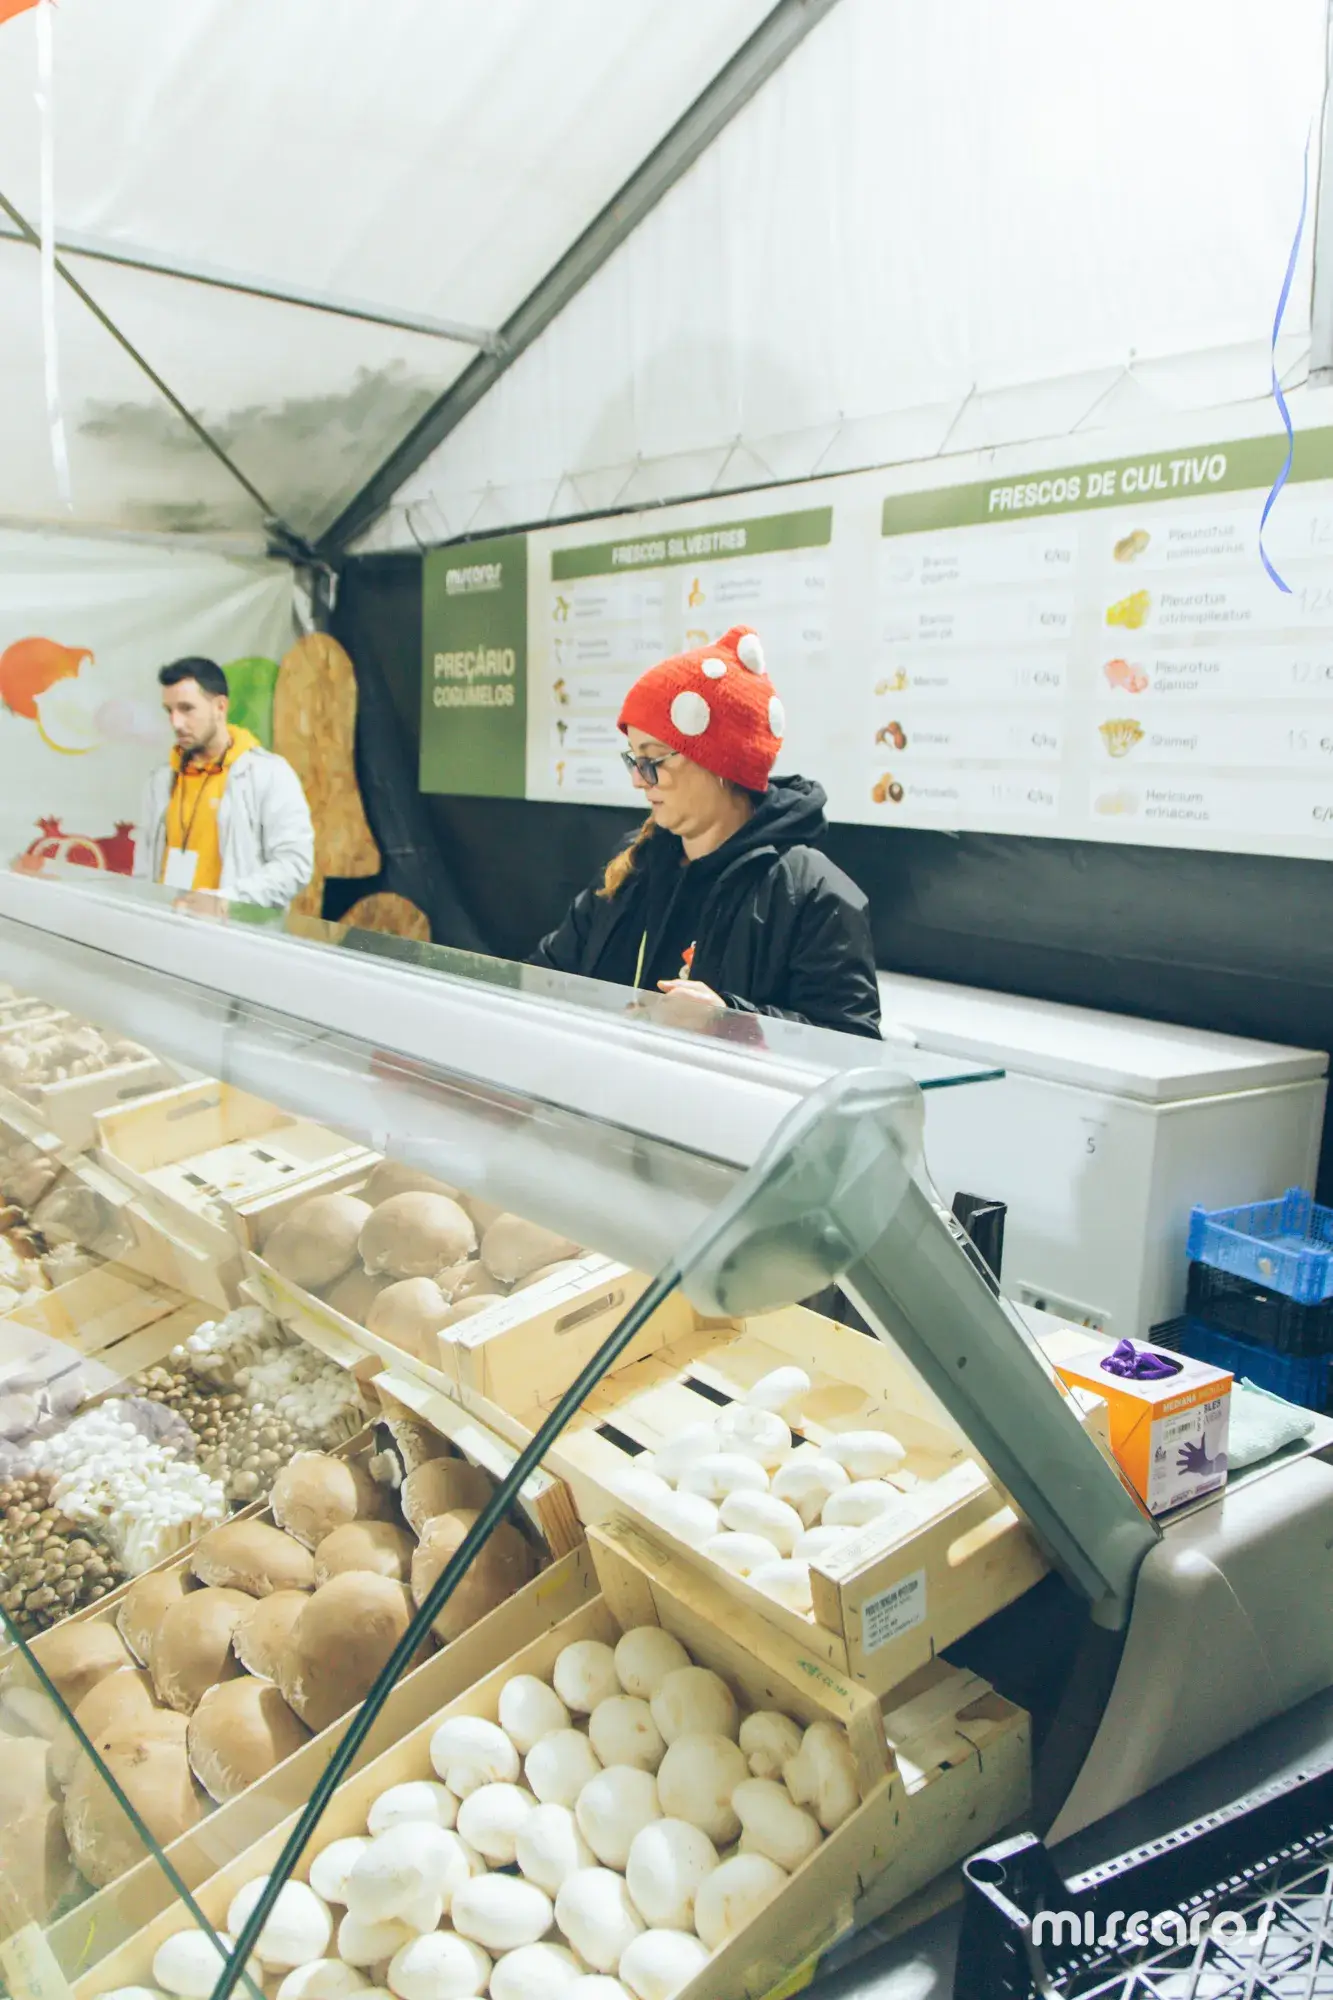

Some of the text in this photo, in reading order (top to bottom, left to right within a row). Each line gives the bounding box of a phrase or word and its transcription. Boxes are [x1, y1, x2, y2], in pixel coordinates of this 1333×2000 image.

[988, 453, 1227, 513] FRESCOS DE CULTIVO
[611, 527, 747, 565] FRESCOS SILVESTRES
[1160, 591, 1227, 609] Pleurotus
[434, 643, 516, 684] PREÇÁRIO
[1155, 660, 1221, 676] Pleurotus
[432, 684, 515, 708] COGUMELOS
